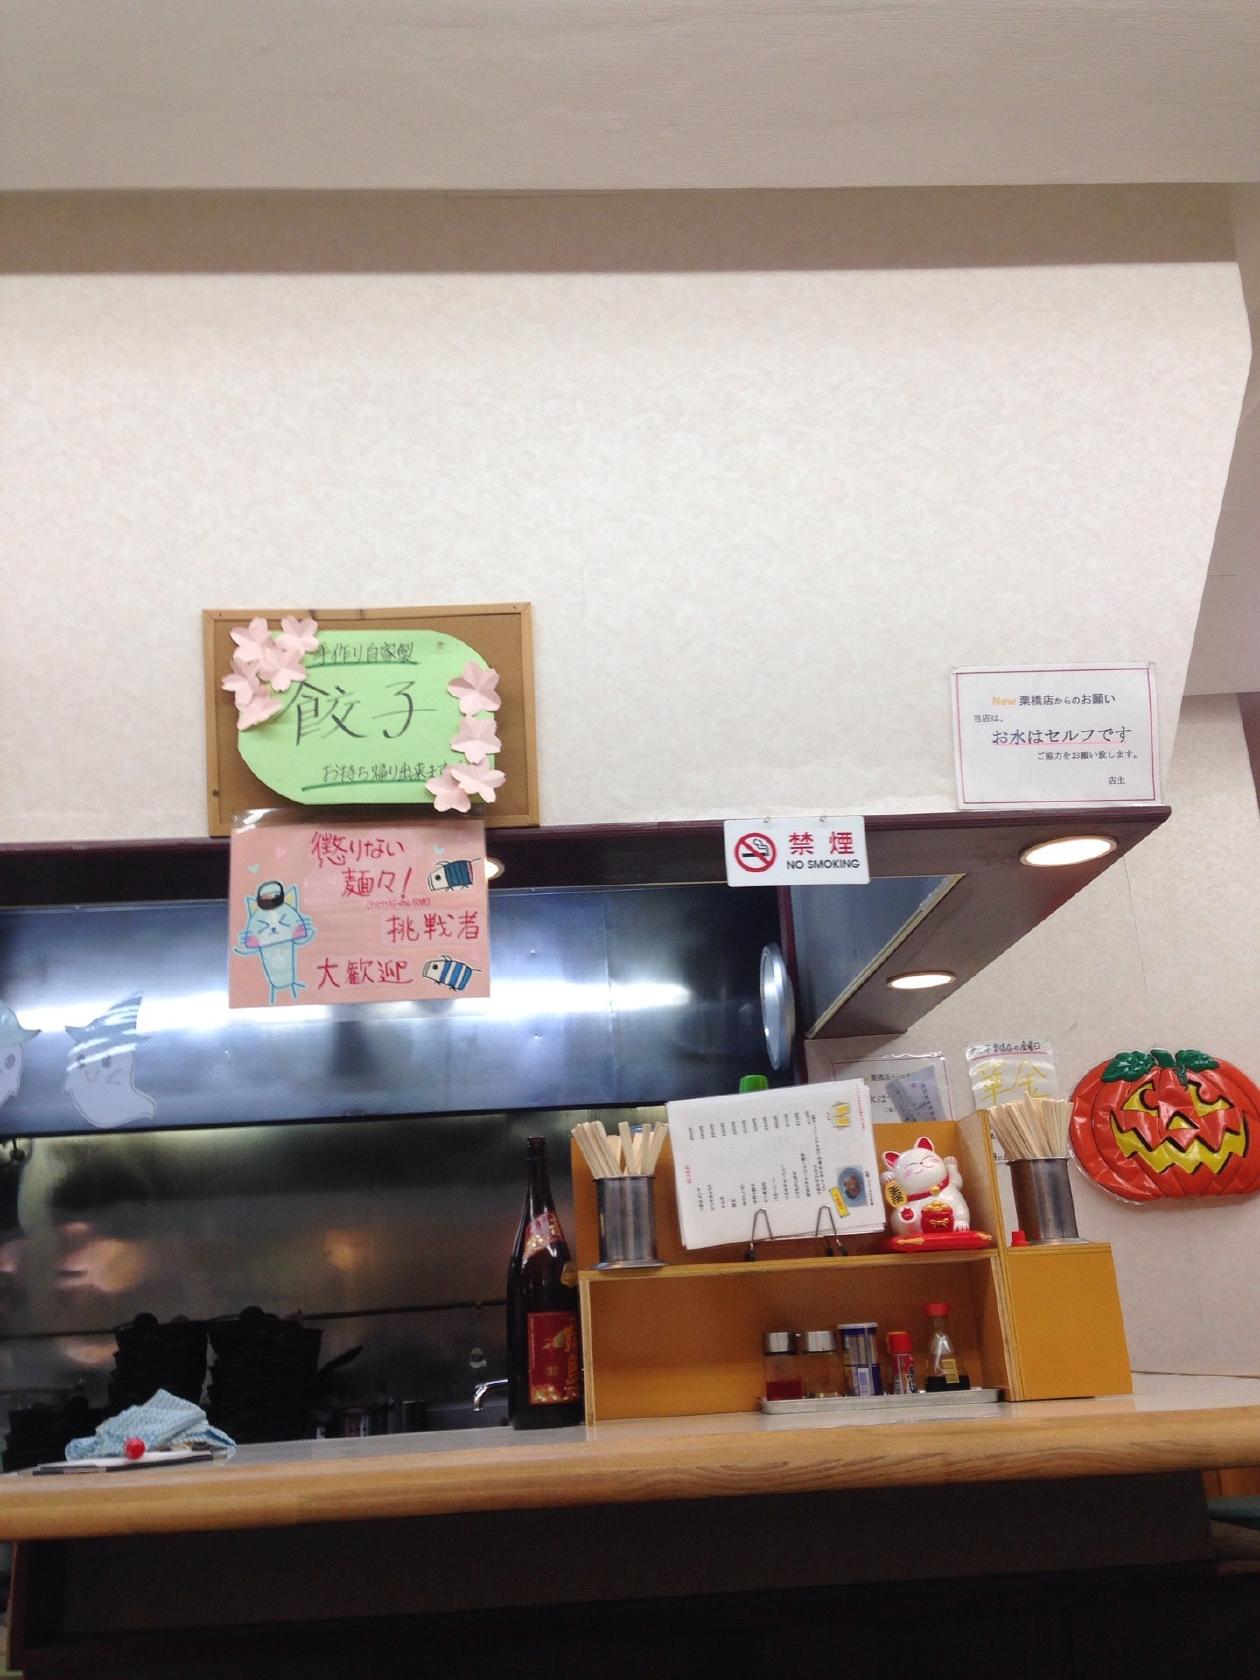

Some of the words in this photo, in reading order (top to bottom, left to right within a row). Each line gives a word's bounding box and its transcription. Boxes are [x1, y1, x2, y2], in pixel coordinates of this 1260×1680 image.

[992, 697, 1017, 706] New
[1019, 693, 1116, 706] 栗橋店からのお願い
[277, 680, 437, 747] 餃子
[992, 726, 1132, 745] お水はセルフです
[1037, 749, 1138, 760] ご協力をお願い致します。
[1108, 776, 1125, 785] 店主
[311, 831, 406, 868] 懲りない
[788, 831, 855, 855] 禁煙
[786, 860, 804, 869] NO
[807, 859, 860, 869] SMOKING
[386, 910, 480, 943] 挑戦者
[316, 957, 414, 990] 大歓迎
